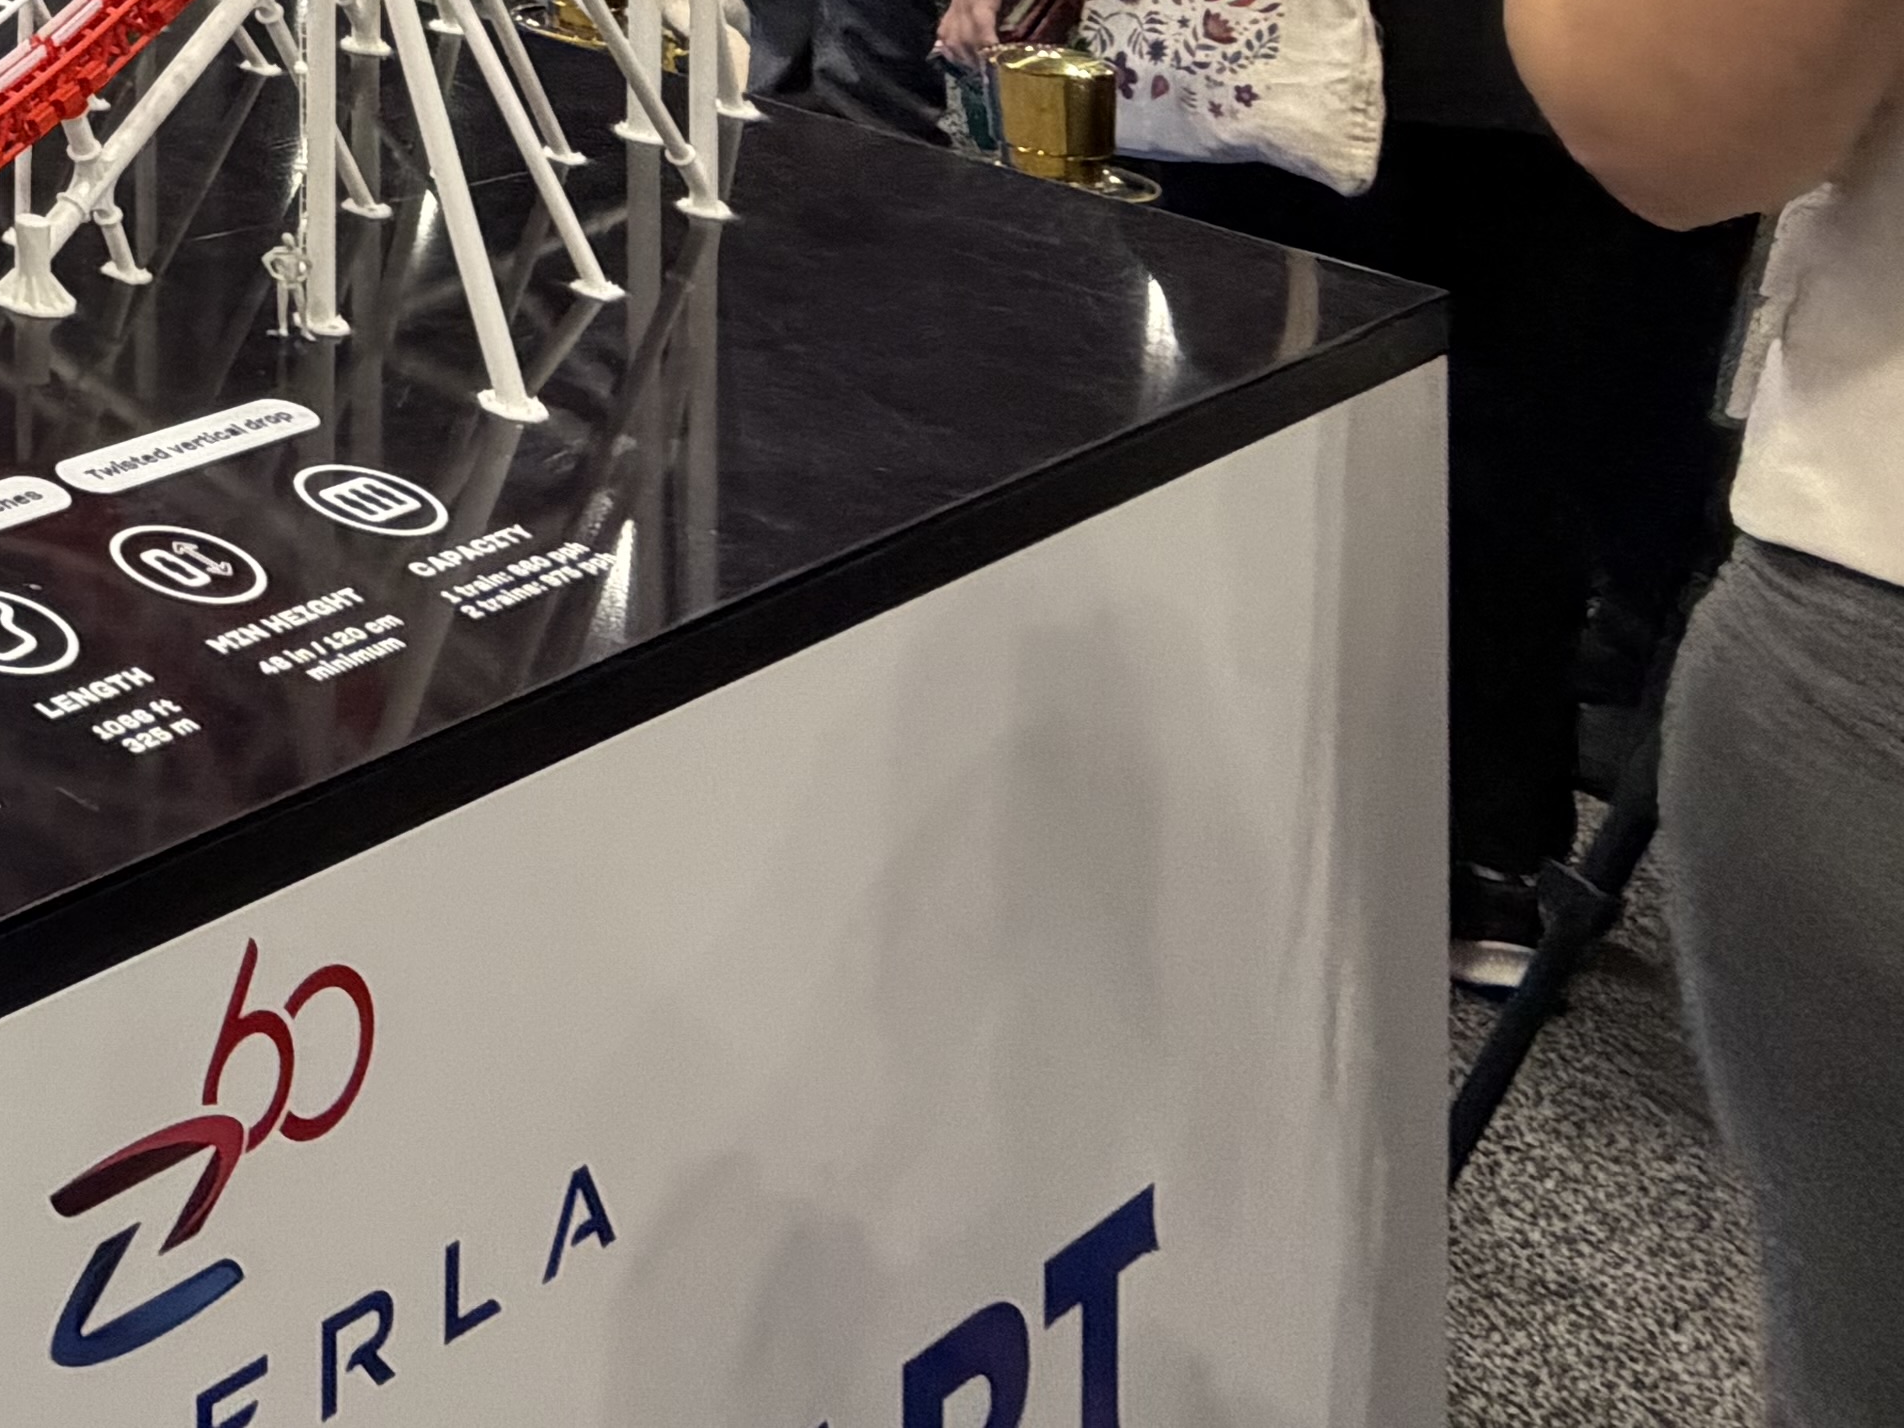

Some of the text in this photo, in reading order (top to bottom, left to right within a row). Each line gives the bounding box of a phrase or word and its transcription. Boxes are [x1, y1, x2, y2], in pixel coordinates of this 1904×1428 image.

[84, 408, 295, 483] Twisted vertical drop
[407, 524, 534, 578] CAPACITY
[440, 589, 461, 604] 1
[453, 569, 514, 602] train:
[546, 540, 591, 565] pph
[204, 586, 366, 655] MIN HEIGHT
[460, 603, 485, 620] 2
[258, 655, 292, 675] 48
[282, 647, 318, 664] in
[323, 626, 369, 651] 120
[364, 614, 406, 634] cm
[305, 636, 408, 682] minimum
[32, 666, 156, 720] LENGTH
[148, 698, 183, 717] ft
[121, 717, 202, 754] 325 m
